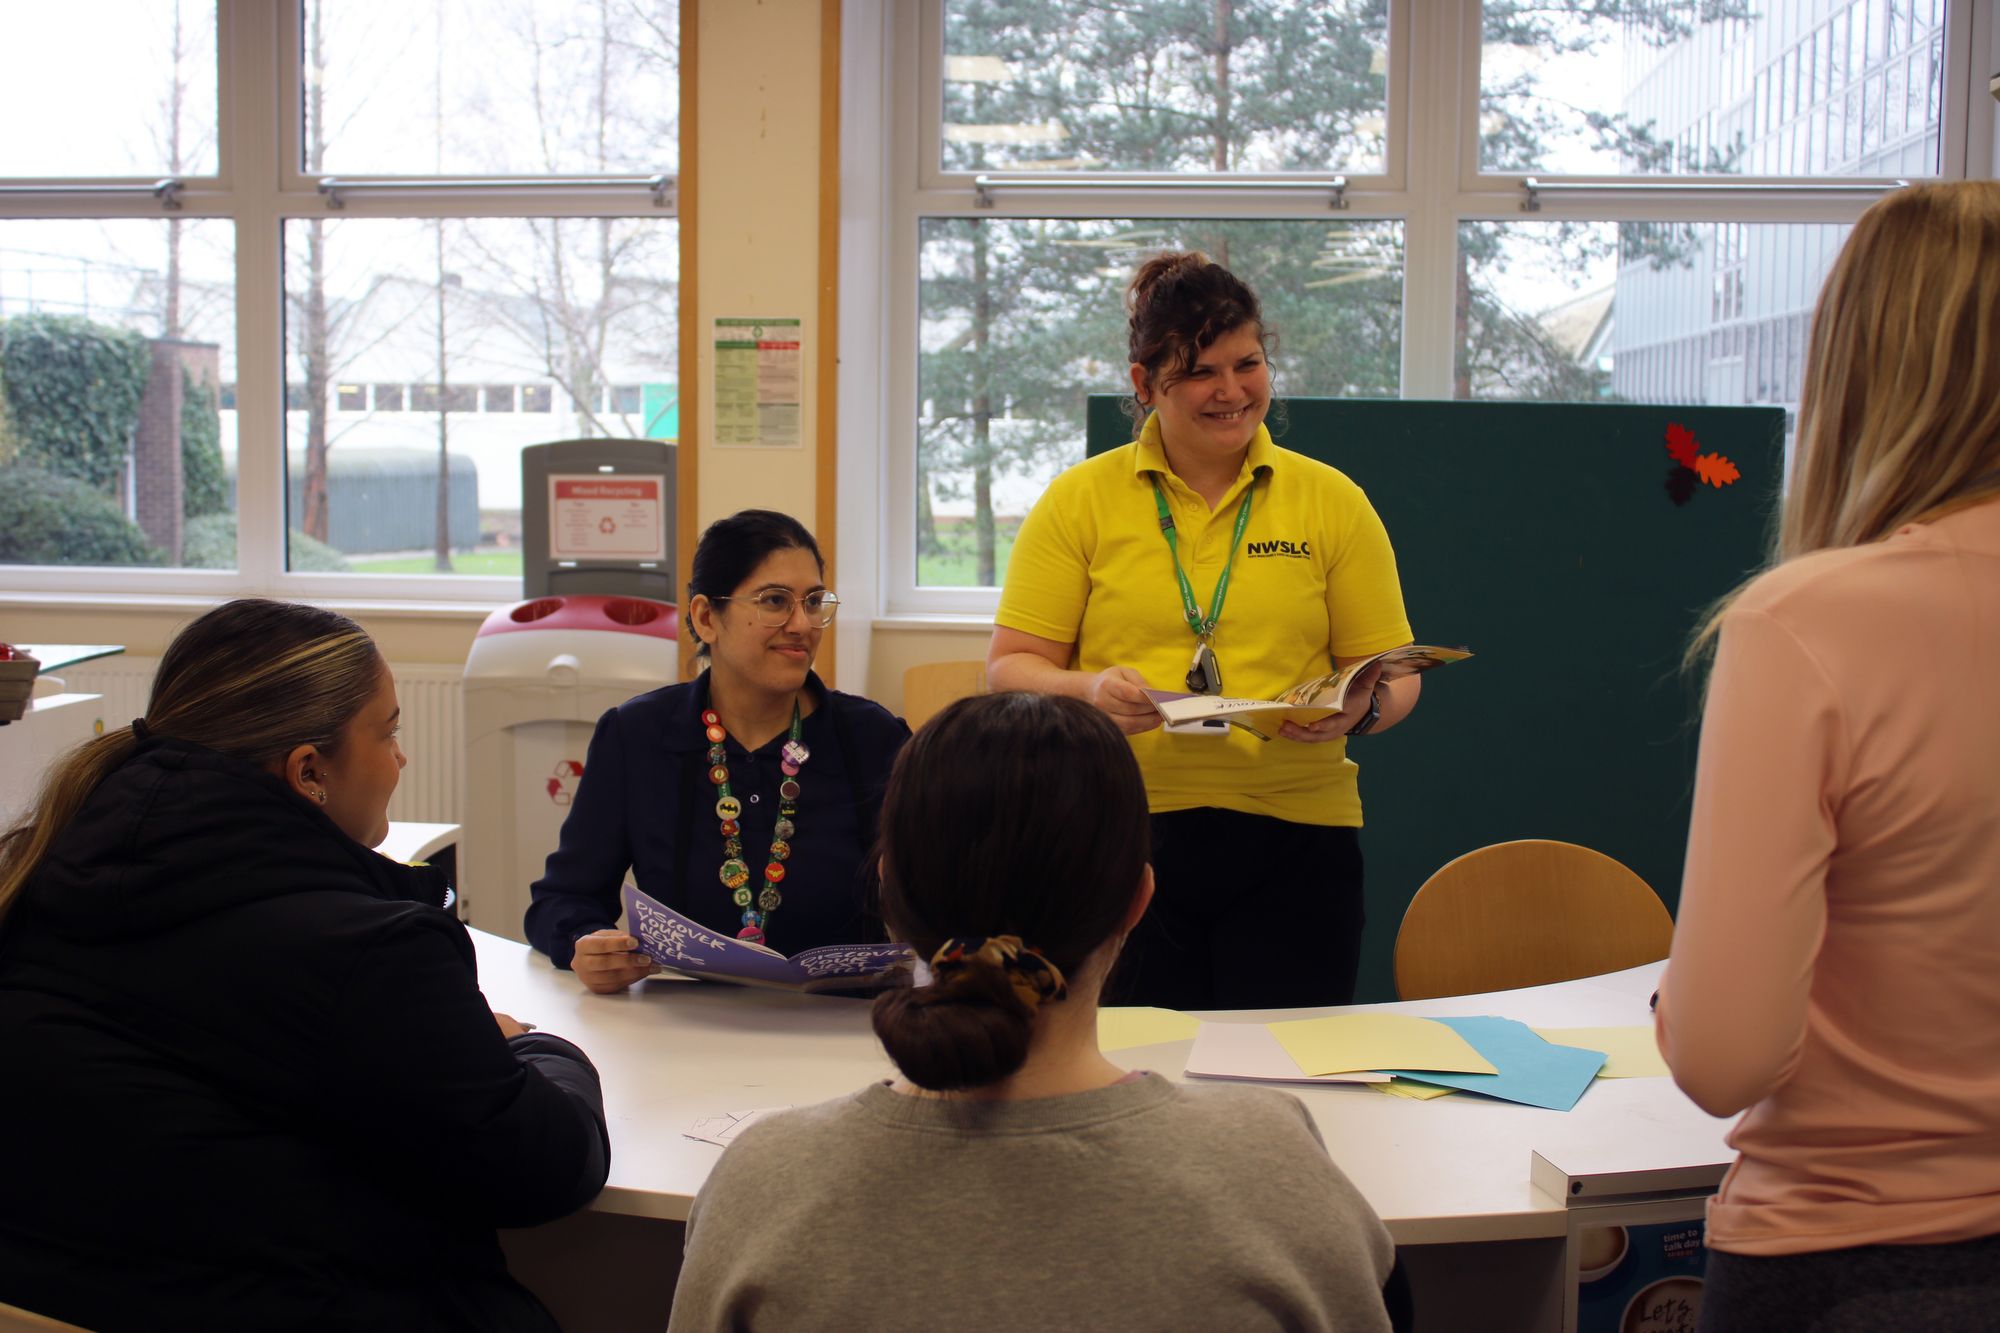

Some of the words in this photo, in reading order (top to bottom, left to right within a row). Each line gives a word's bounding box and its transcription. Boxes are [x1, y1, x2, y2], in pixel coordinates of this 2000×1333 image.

[1247, 540, 1311, 555] NWSLC
[727, 871, 749, 888] HULK
[635, 900, 726, 951] DISCOVER
[638, 910, 686, 943] YOUR
[640, 922, 687, 951] NEXT
[640, 933, 706, 966] STEPS
[1663, 1232, 1685, 1243] time
[1687, 1229, 1698, 1238] to
[1663, 1241, 1682, 1252] talk
[1683, 1239, 1700, 1250] day
